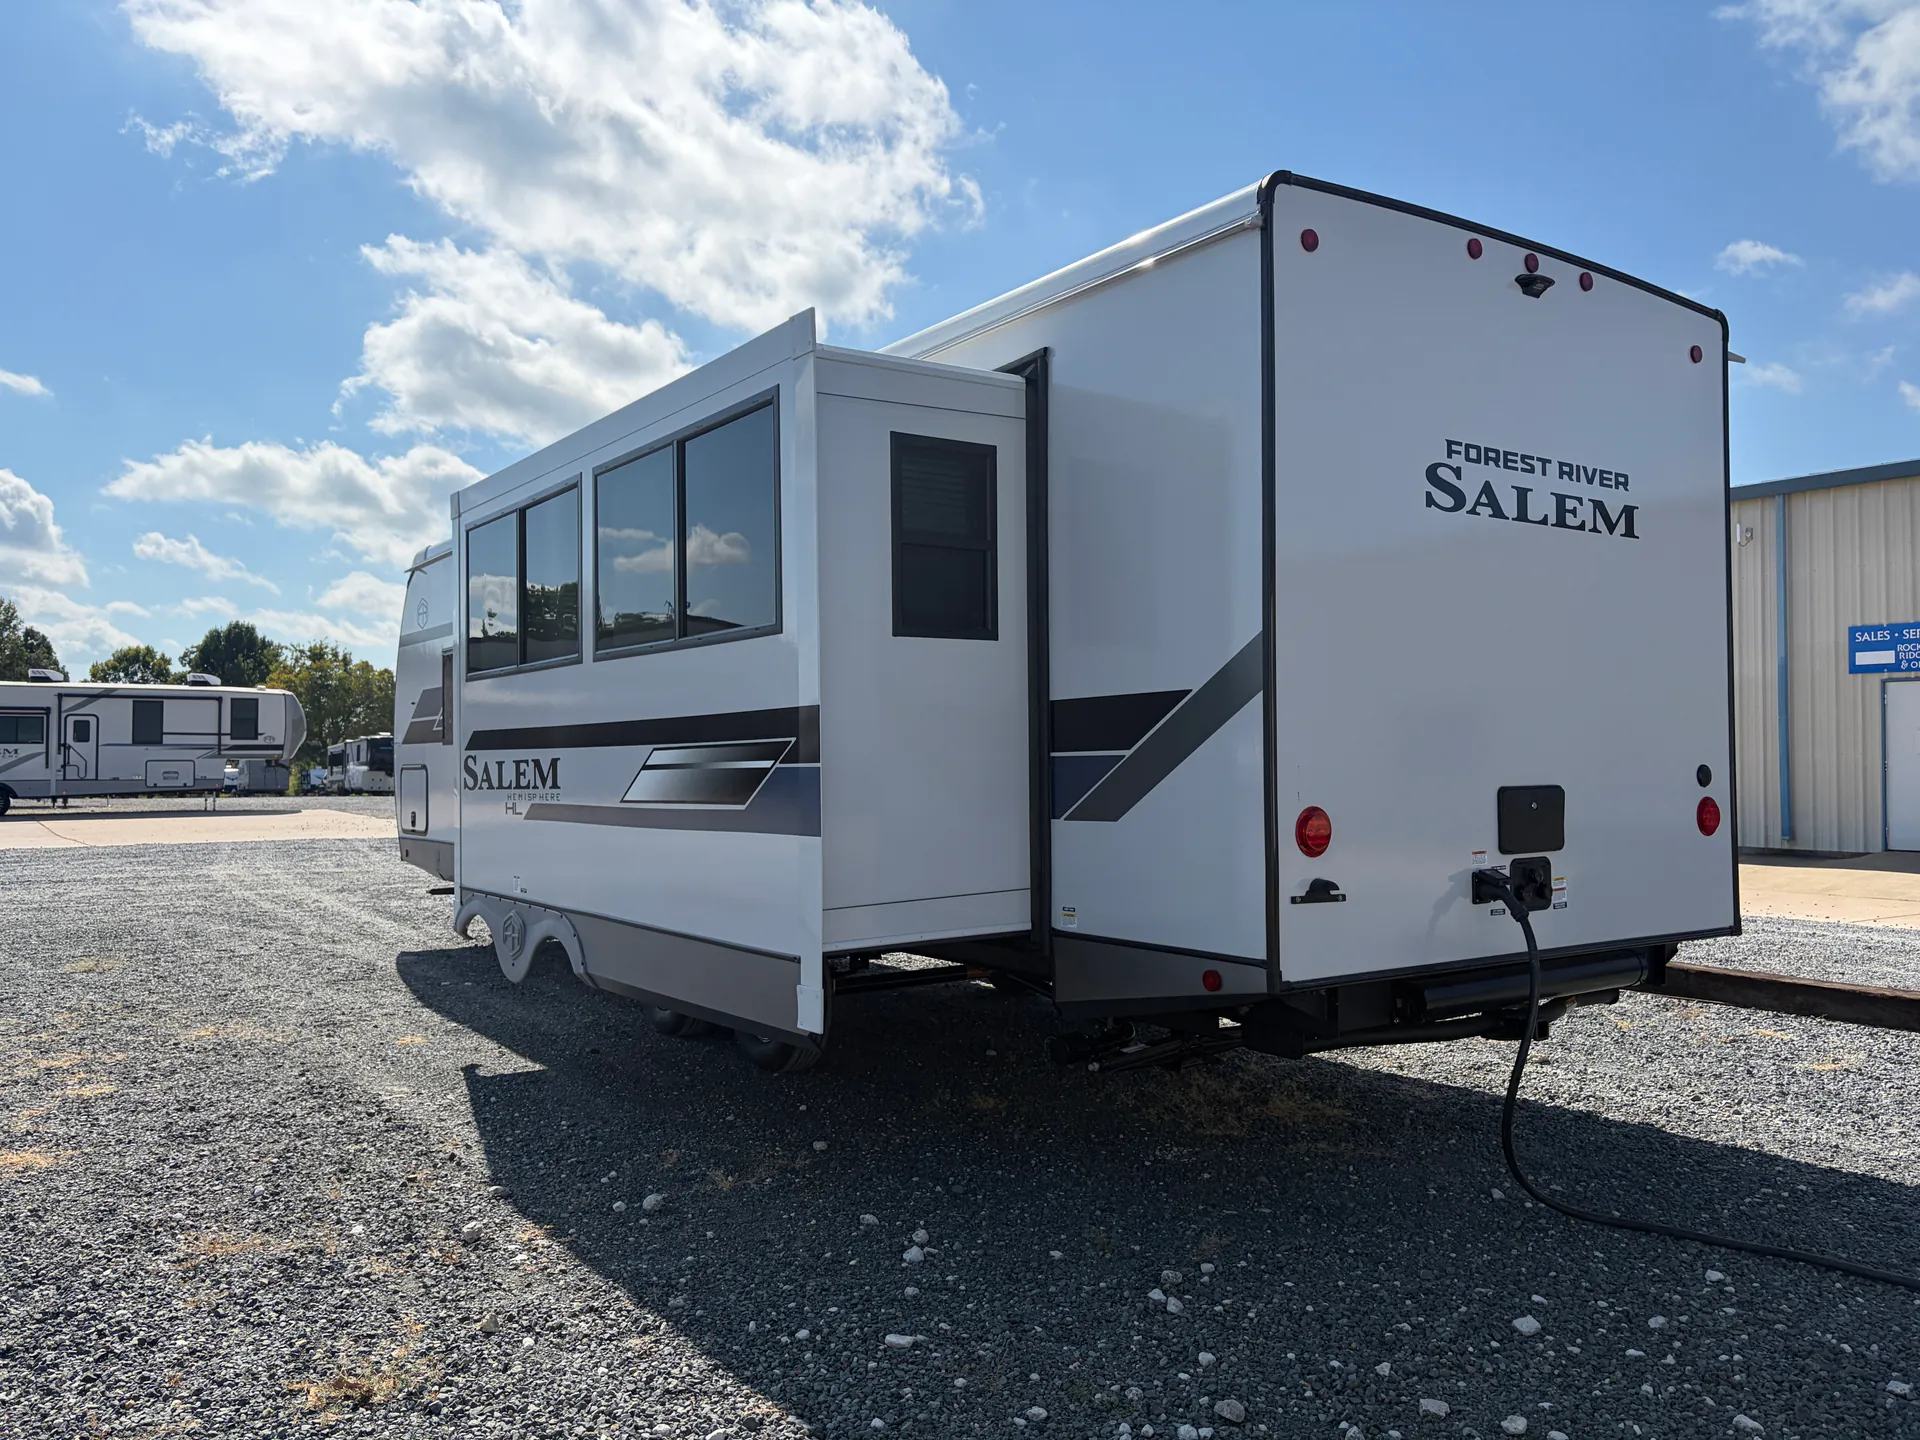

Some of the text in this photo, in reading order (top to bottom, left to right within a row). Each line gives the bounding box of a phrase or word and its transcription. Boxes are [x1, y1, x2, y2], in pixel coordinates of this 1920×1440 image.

[1445, 439, 1630, 492] FOREST RIVER
[1425, 462, 1640, 539] SALEM
[1855, 630, 1890, 642] SALES
[1900, 659, 1920, 670] & O
[463, 754, 561, 791] SALEM
[507, 793, 561, 802] HEMISPHERE
[505, 802, 523, 816] HL
